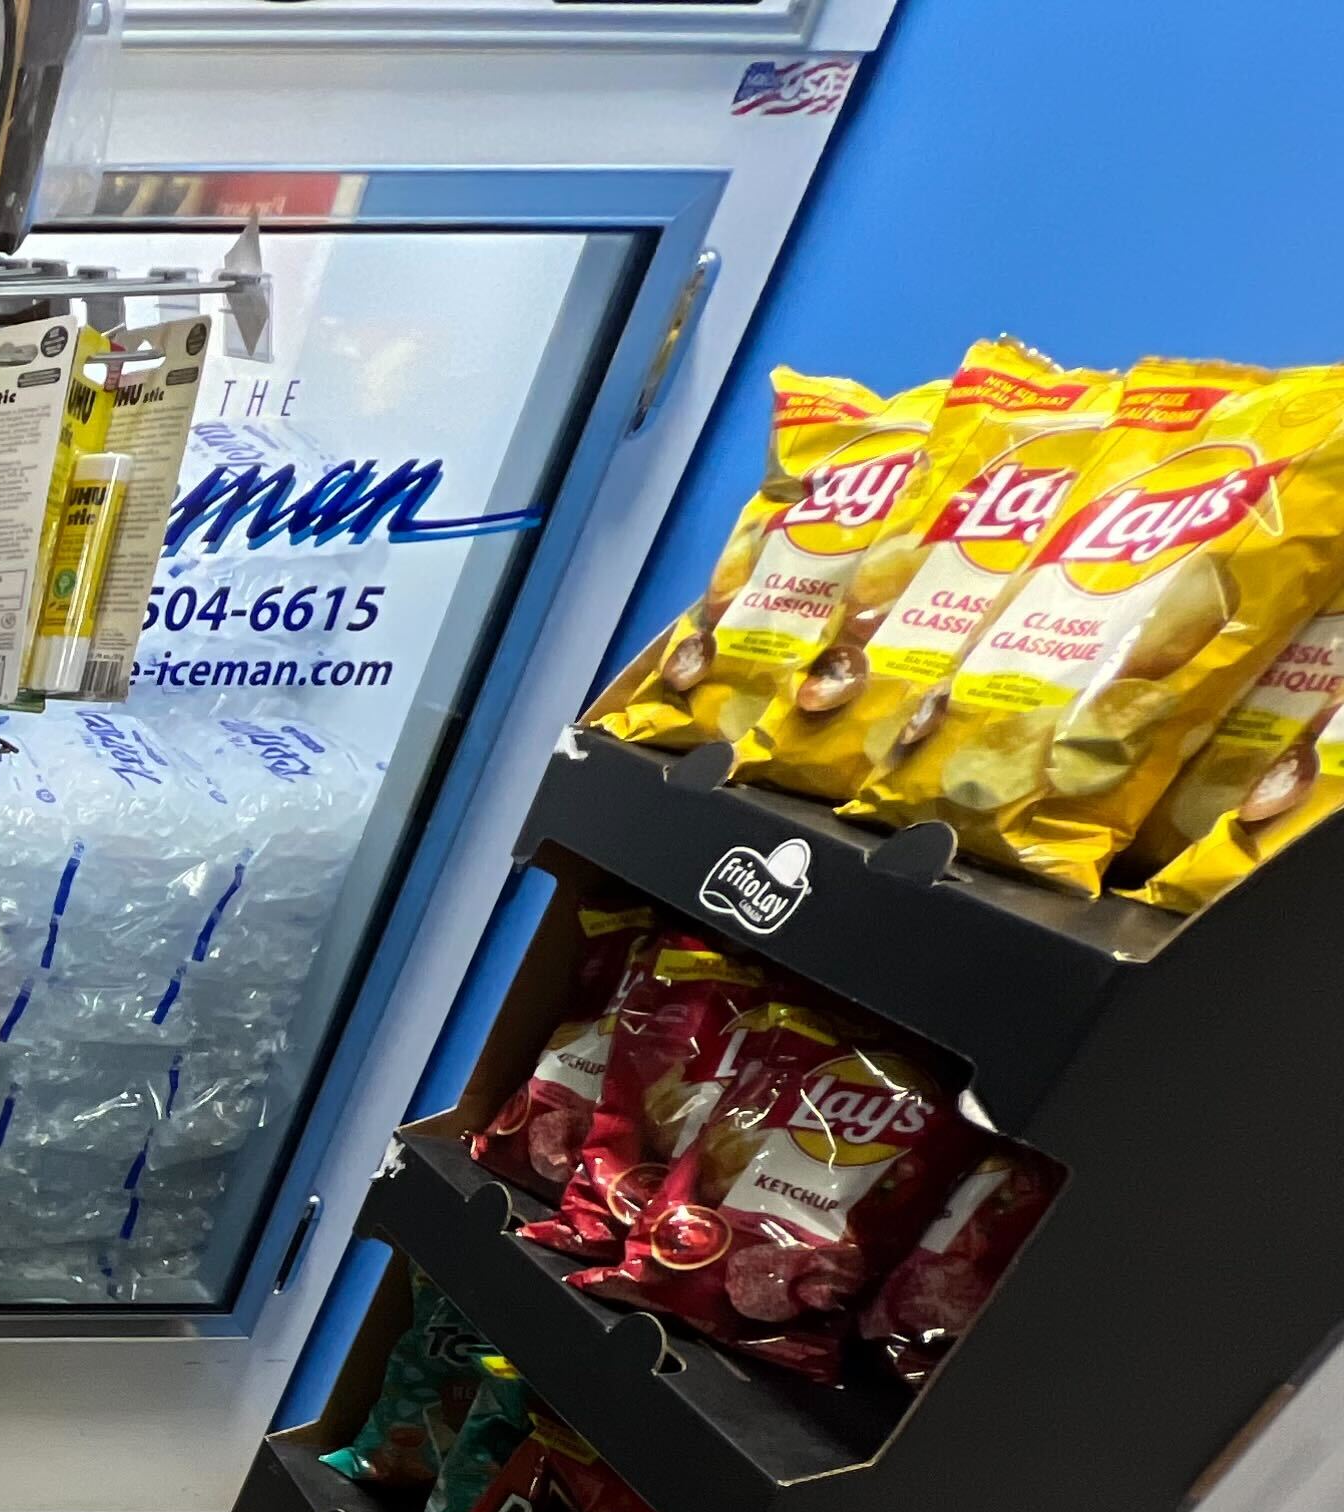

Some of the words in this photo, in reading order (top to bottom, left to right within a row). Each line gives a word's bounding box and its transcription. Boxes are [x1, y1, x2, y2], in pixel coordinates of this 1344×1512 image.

[219, 380, 302, 418] THE
[1063, 471, 1249, 564] Lay's
[764, 572, 840, 600] CLASSIC
[989, 630, 1103, 663] CLASSIQUE
[789, 1072, 936, 1148] Lay's
[753, 1173, 840, 1213] KETCHUP
